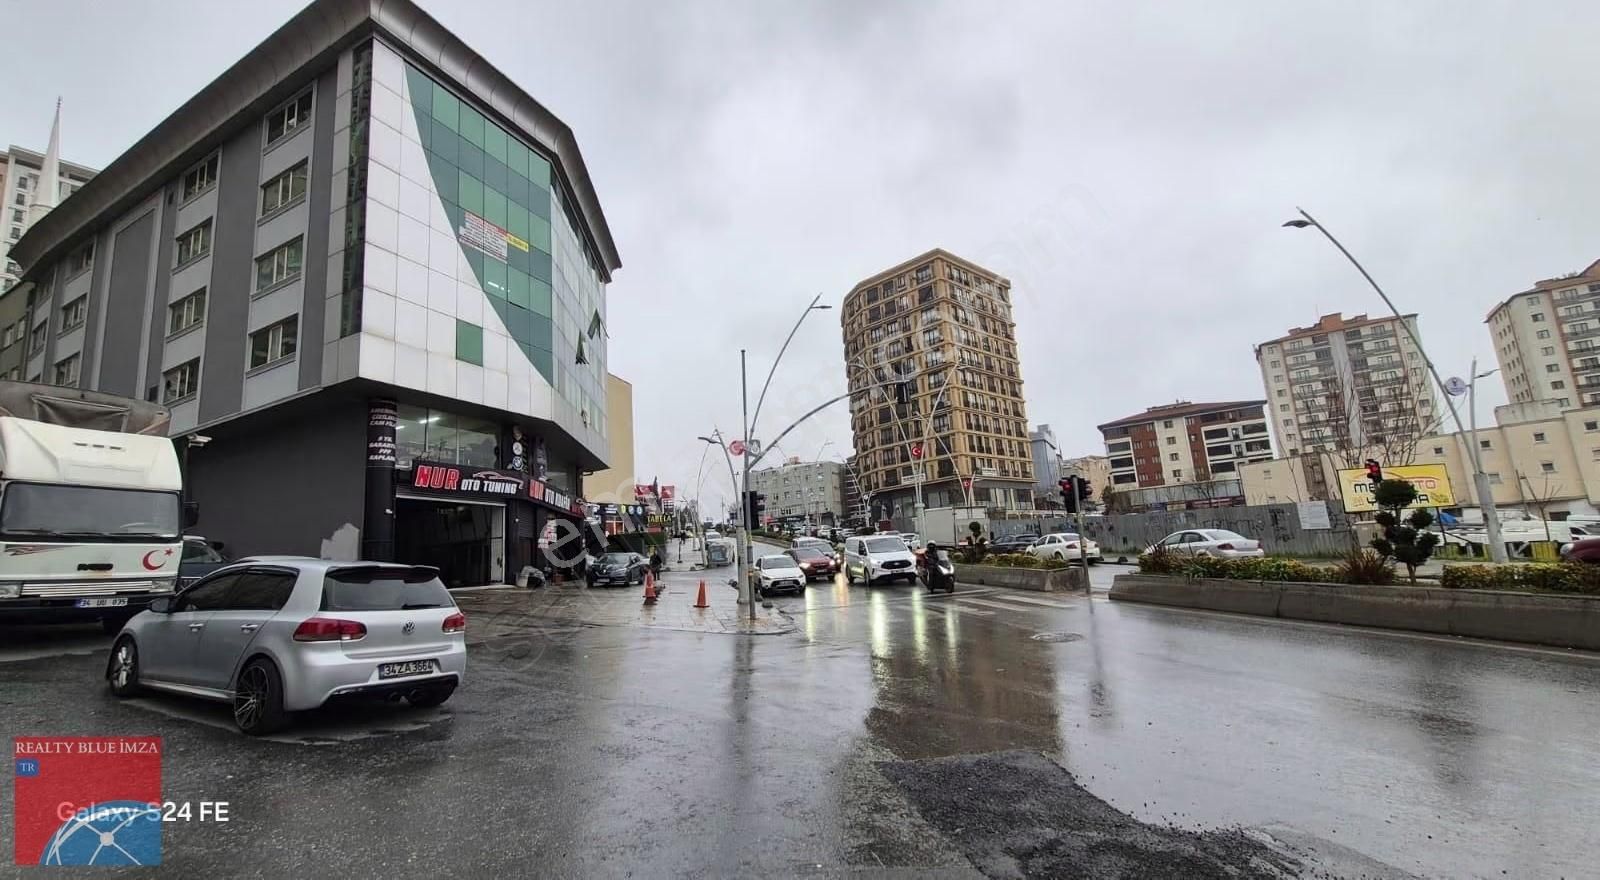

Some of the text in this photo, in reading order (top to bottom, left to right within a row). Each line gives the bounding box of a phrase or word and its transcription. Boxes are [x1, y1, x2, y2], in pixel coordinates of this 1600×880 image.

[415, 465, 518, 495] NUR OTO TUNING
[385, 664, 397, 675] 34
